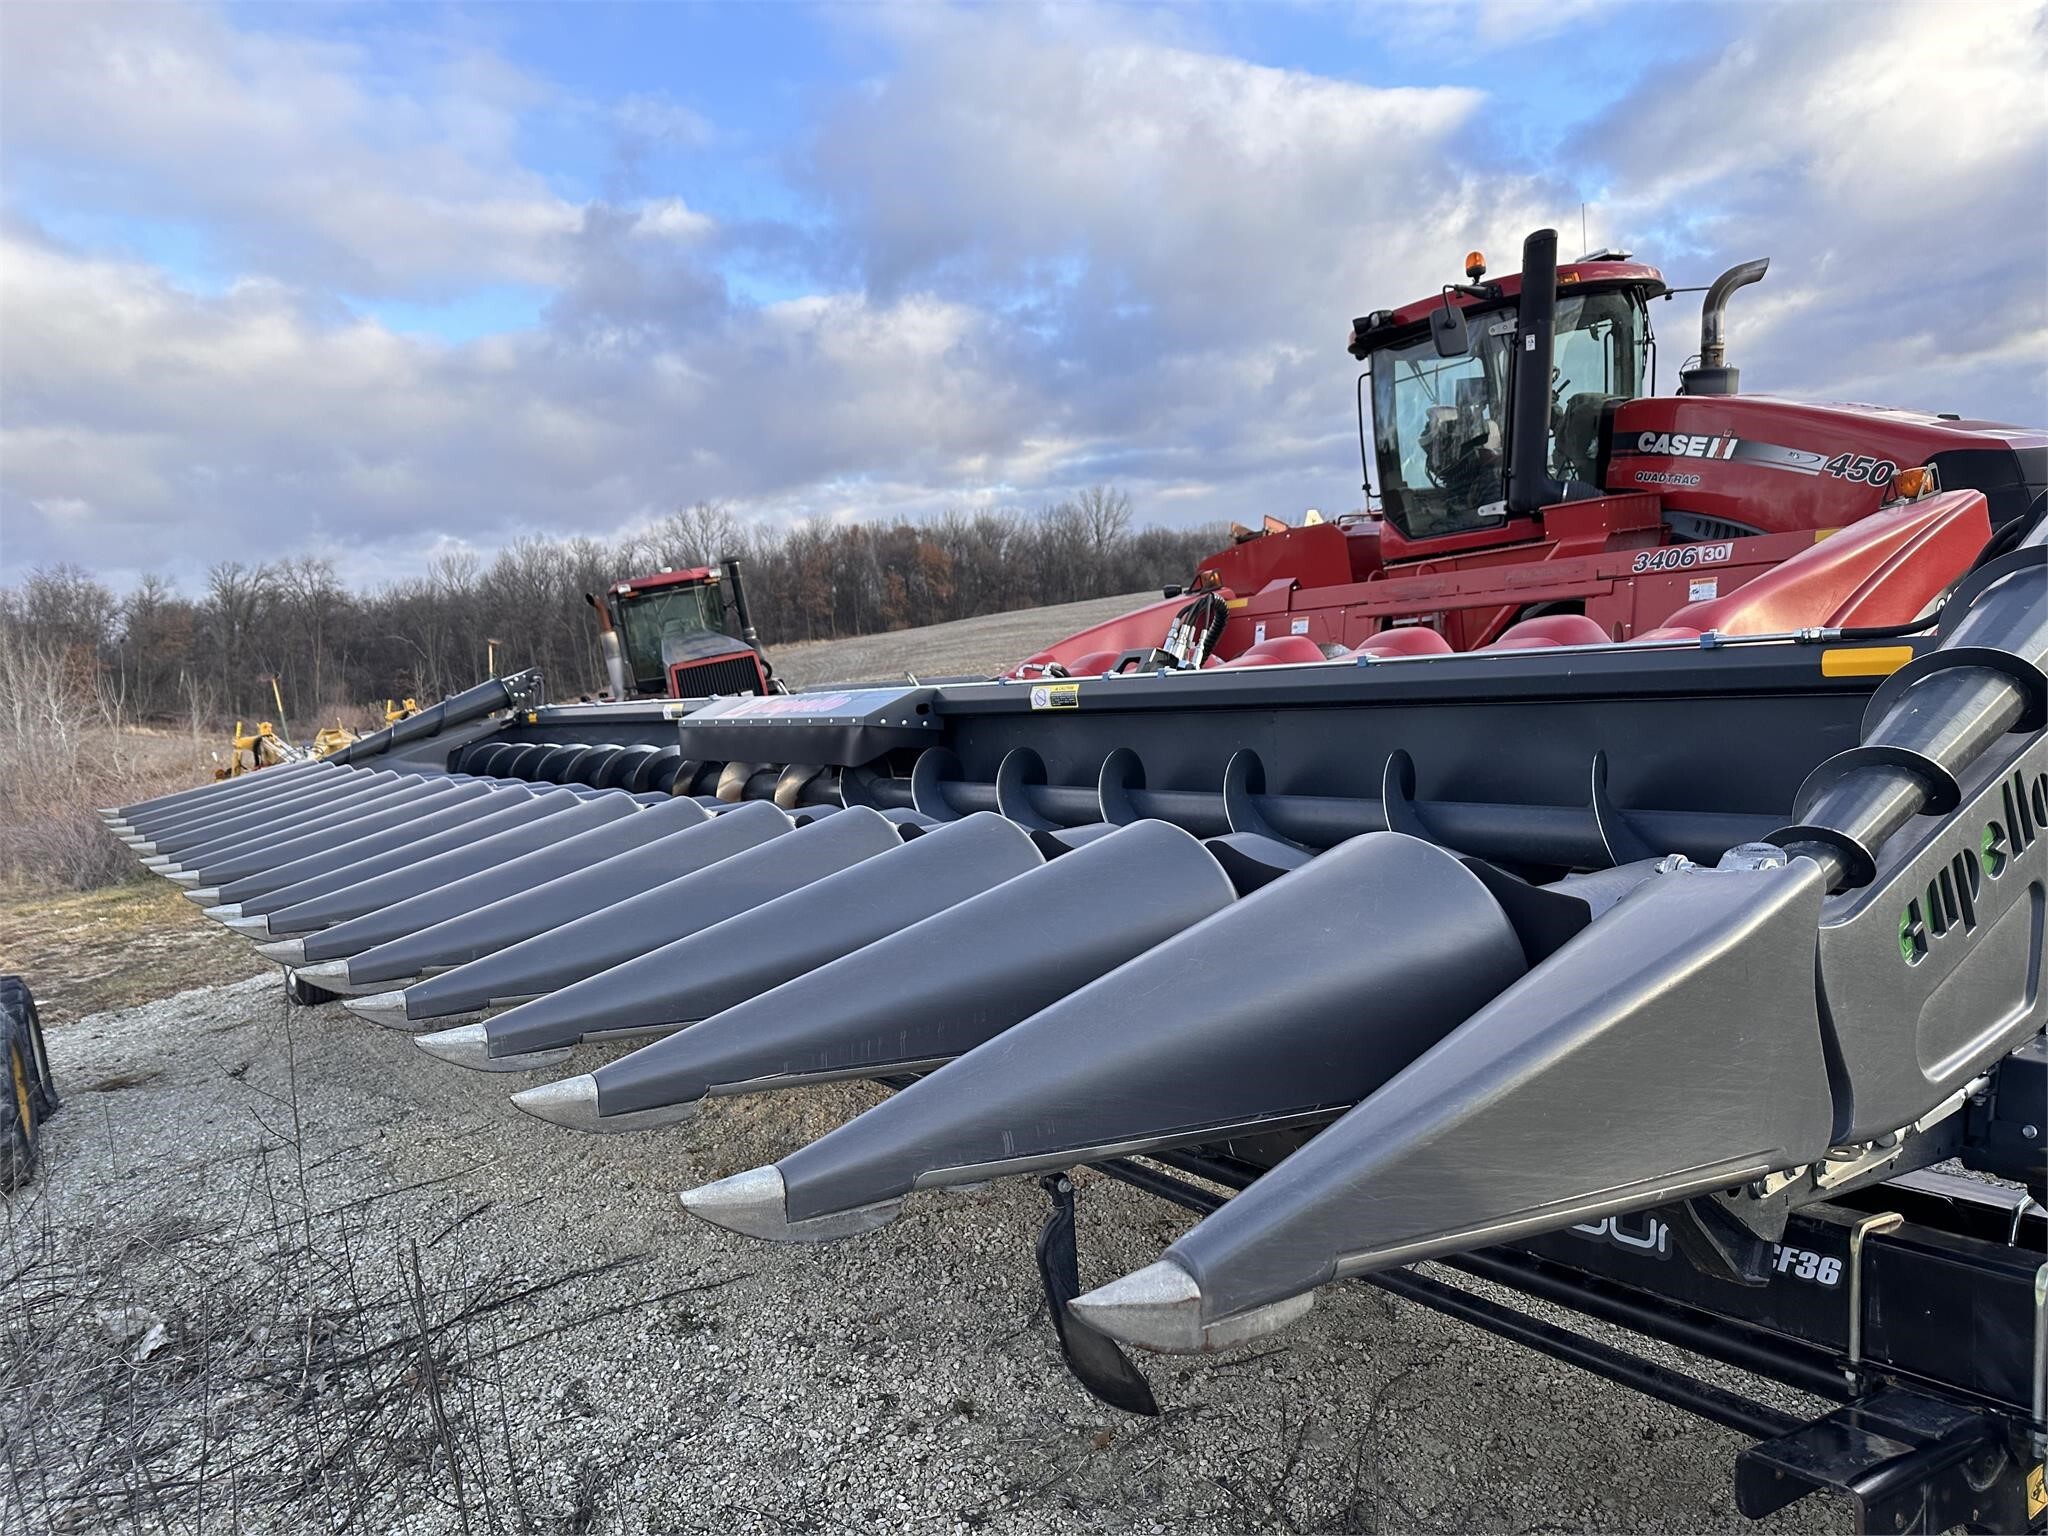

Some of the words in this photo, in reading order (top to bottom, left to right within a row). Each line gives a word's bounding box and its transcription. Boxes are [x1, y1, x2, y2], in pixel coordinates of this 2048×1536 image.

[1638, 431, 1709, 457] CASE
[1635, 471, 1700, 485] QUADTRAC
[1824, 452, 1896, 487] 450
[1632, 546, 1698, 573] 3406
[1704, 546, 1726, 560] 30
